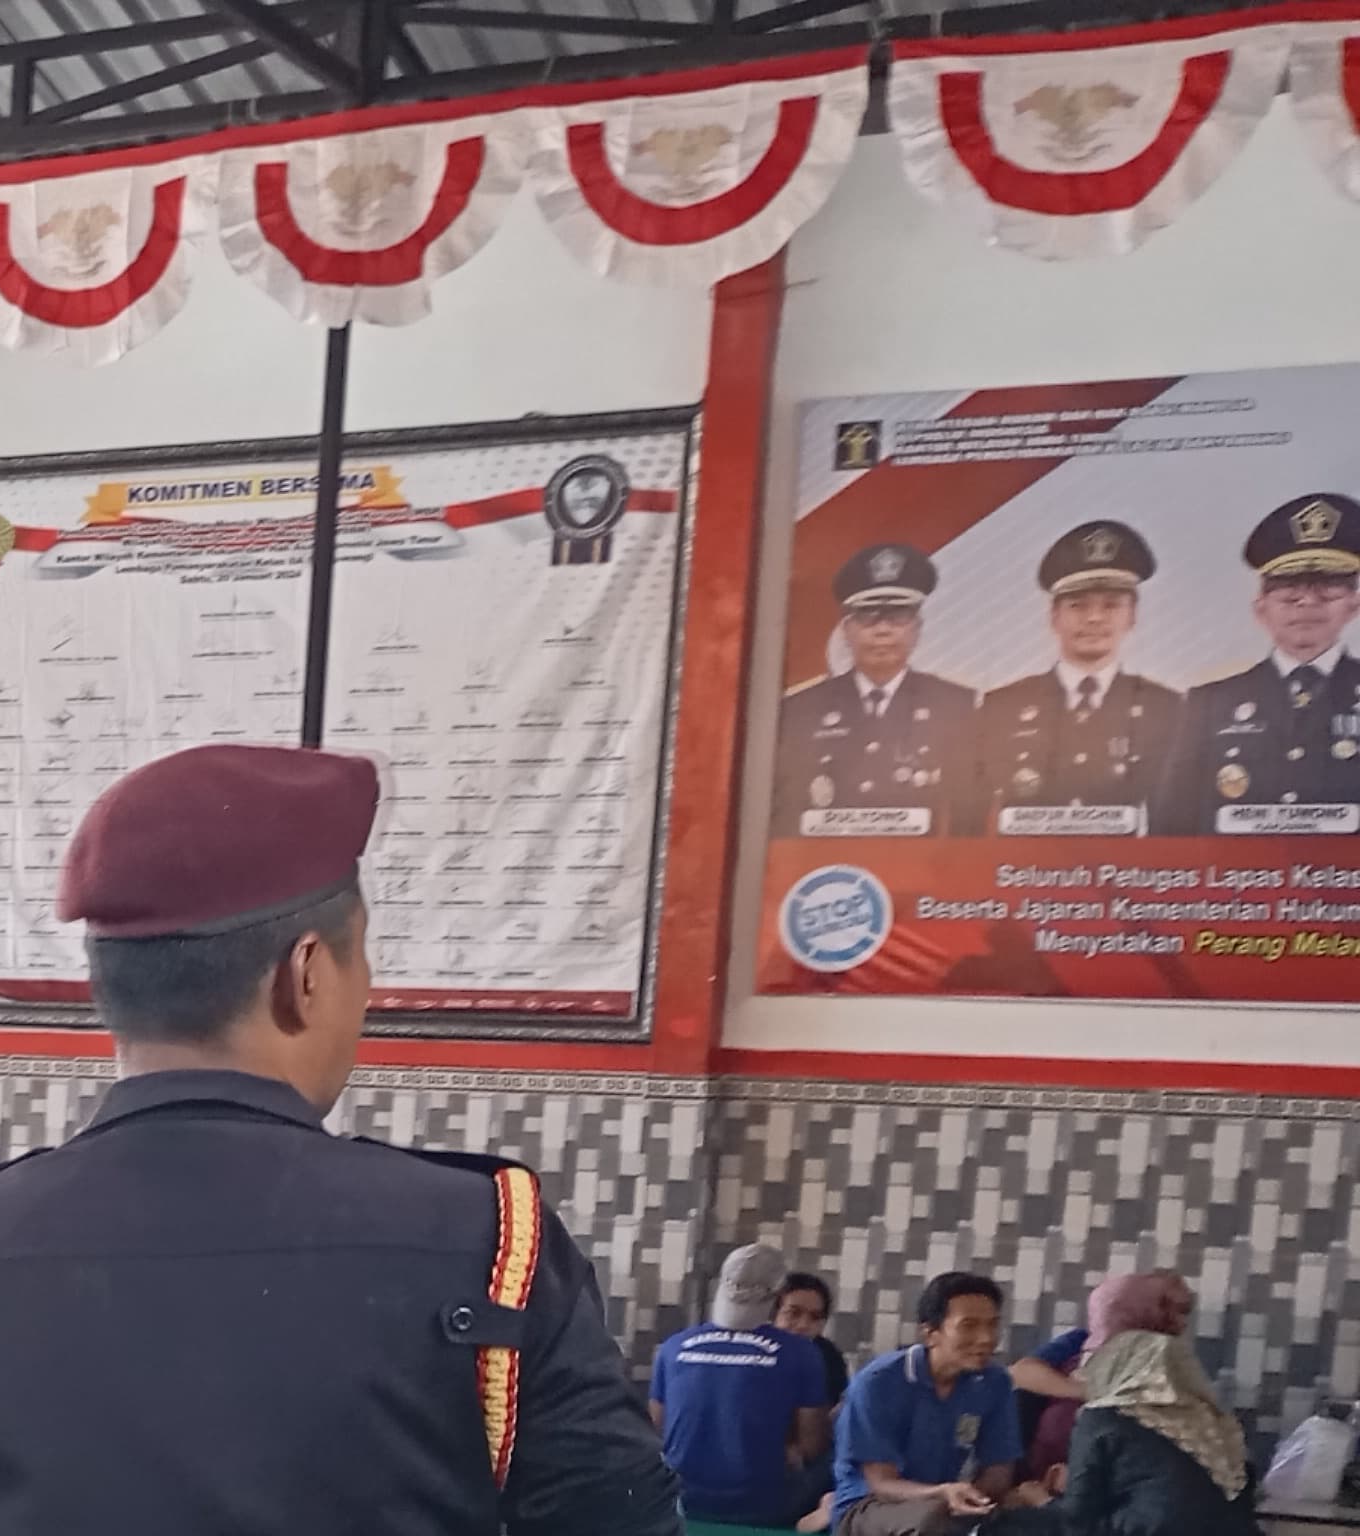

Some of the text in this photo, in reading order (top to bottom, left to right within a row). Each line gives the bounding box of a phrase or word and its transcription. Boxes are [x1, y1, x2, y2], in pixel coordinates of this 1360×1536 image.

[127, 471, 377, 503] KOMITMEN BERSMA
[995, 864, 1092, 888] Seluruh
[1096, 864, 1201, 893] Petugas
[1205, 865, 1285, 893] Lapas
[916, 897, 1009, 920] Beserta
[1012, 899, 1104, 923] Jajaran
[1109, 898, 1271, 921] Kementerian
[1034, 930, 1185, 959] Menyatakan
[1194, 930, 1287, 962] Perang
